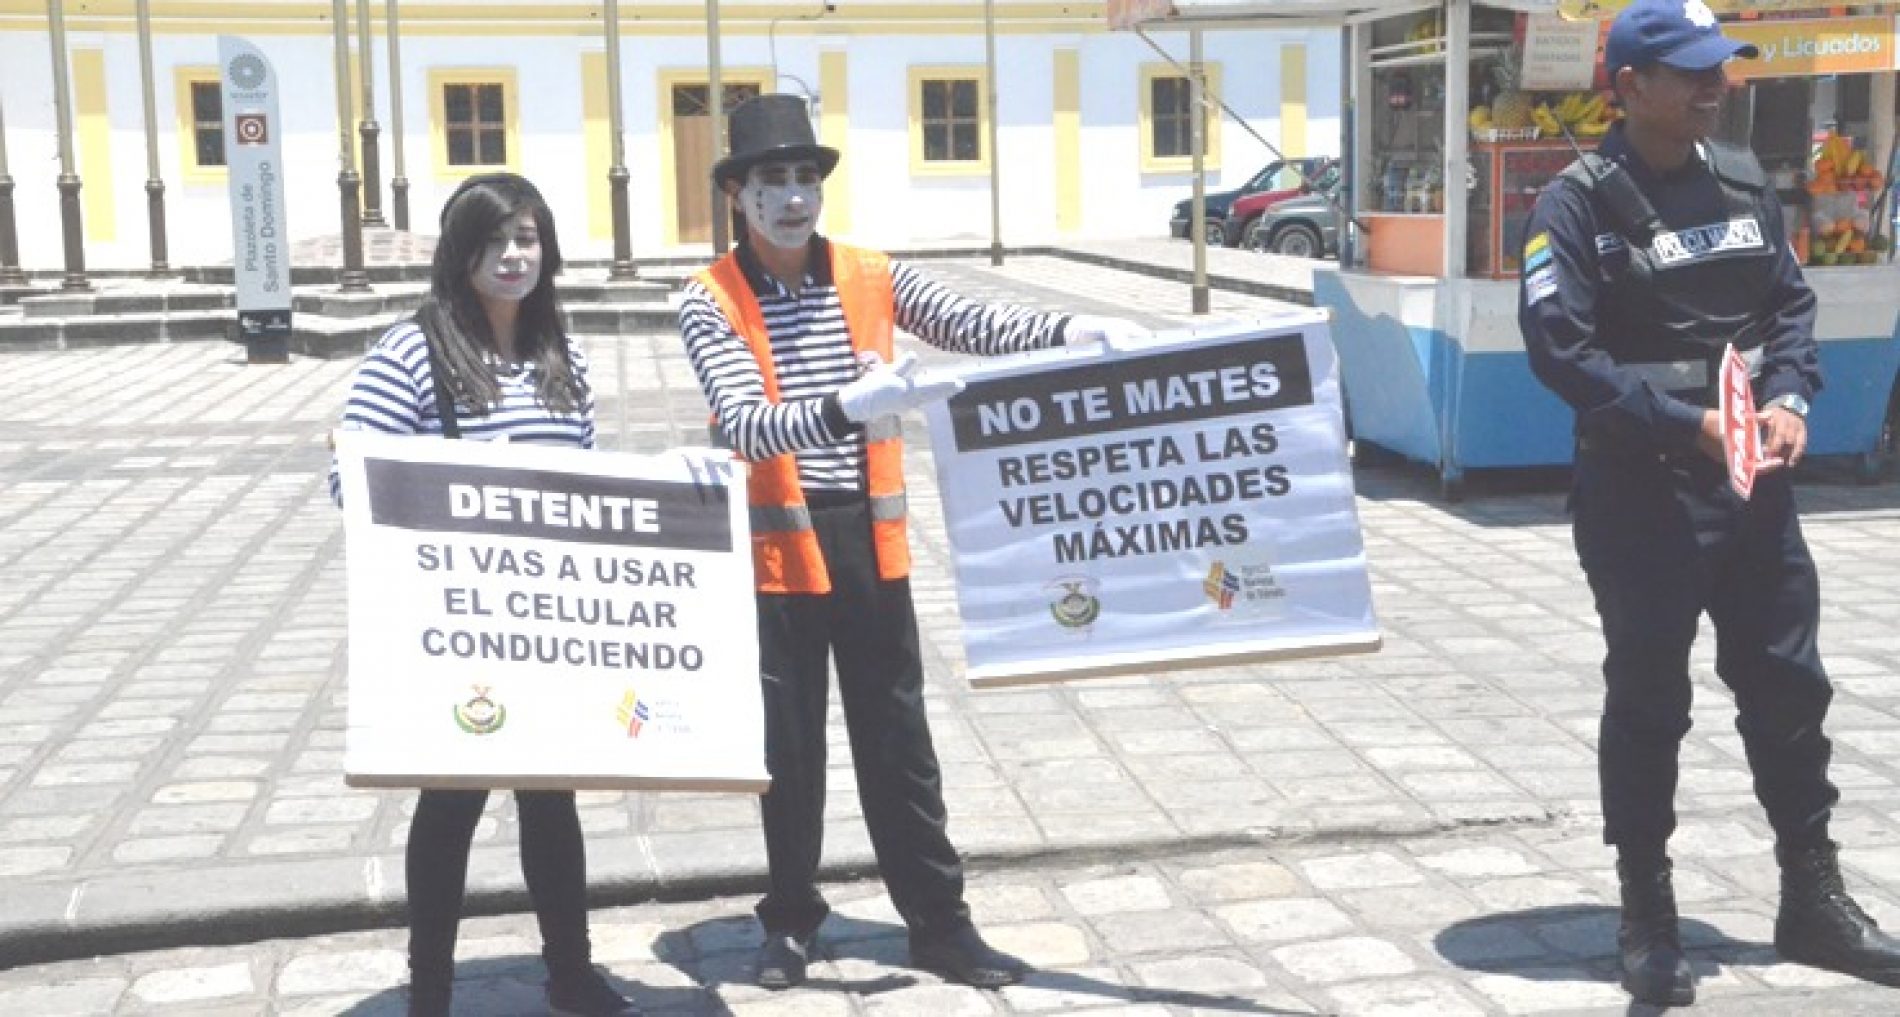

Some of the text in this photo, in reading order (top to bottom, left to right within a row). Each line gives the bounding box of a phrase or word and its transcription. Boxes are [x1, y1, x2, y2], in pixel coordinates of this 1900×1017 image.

[1762, 32, 1881, 63] y Licuados
[241, 183, 258, 271] Plazoleta de
[259, 161, 279, 293] Santo Domingo
[978, 361, 1281, 438] NO TE MATES
[998, 422, 1279, 489] RESPETA LAS
[448, 483, 661, 533] DETENTE
[999, 464, 1291, 528] VELOCIDADES
[1053, 513, 1249, 563] MÁXIMAS
[416, 543, 697, 589] SI VAS A USAR
[443, 587, 677, 629] EL CELULAR
[420, 627, 704, 672] CONDUCIENDO
